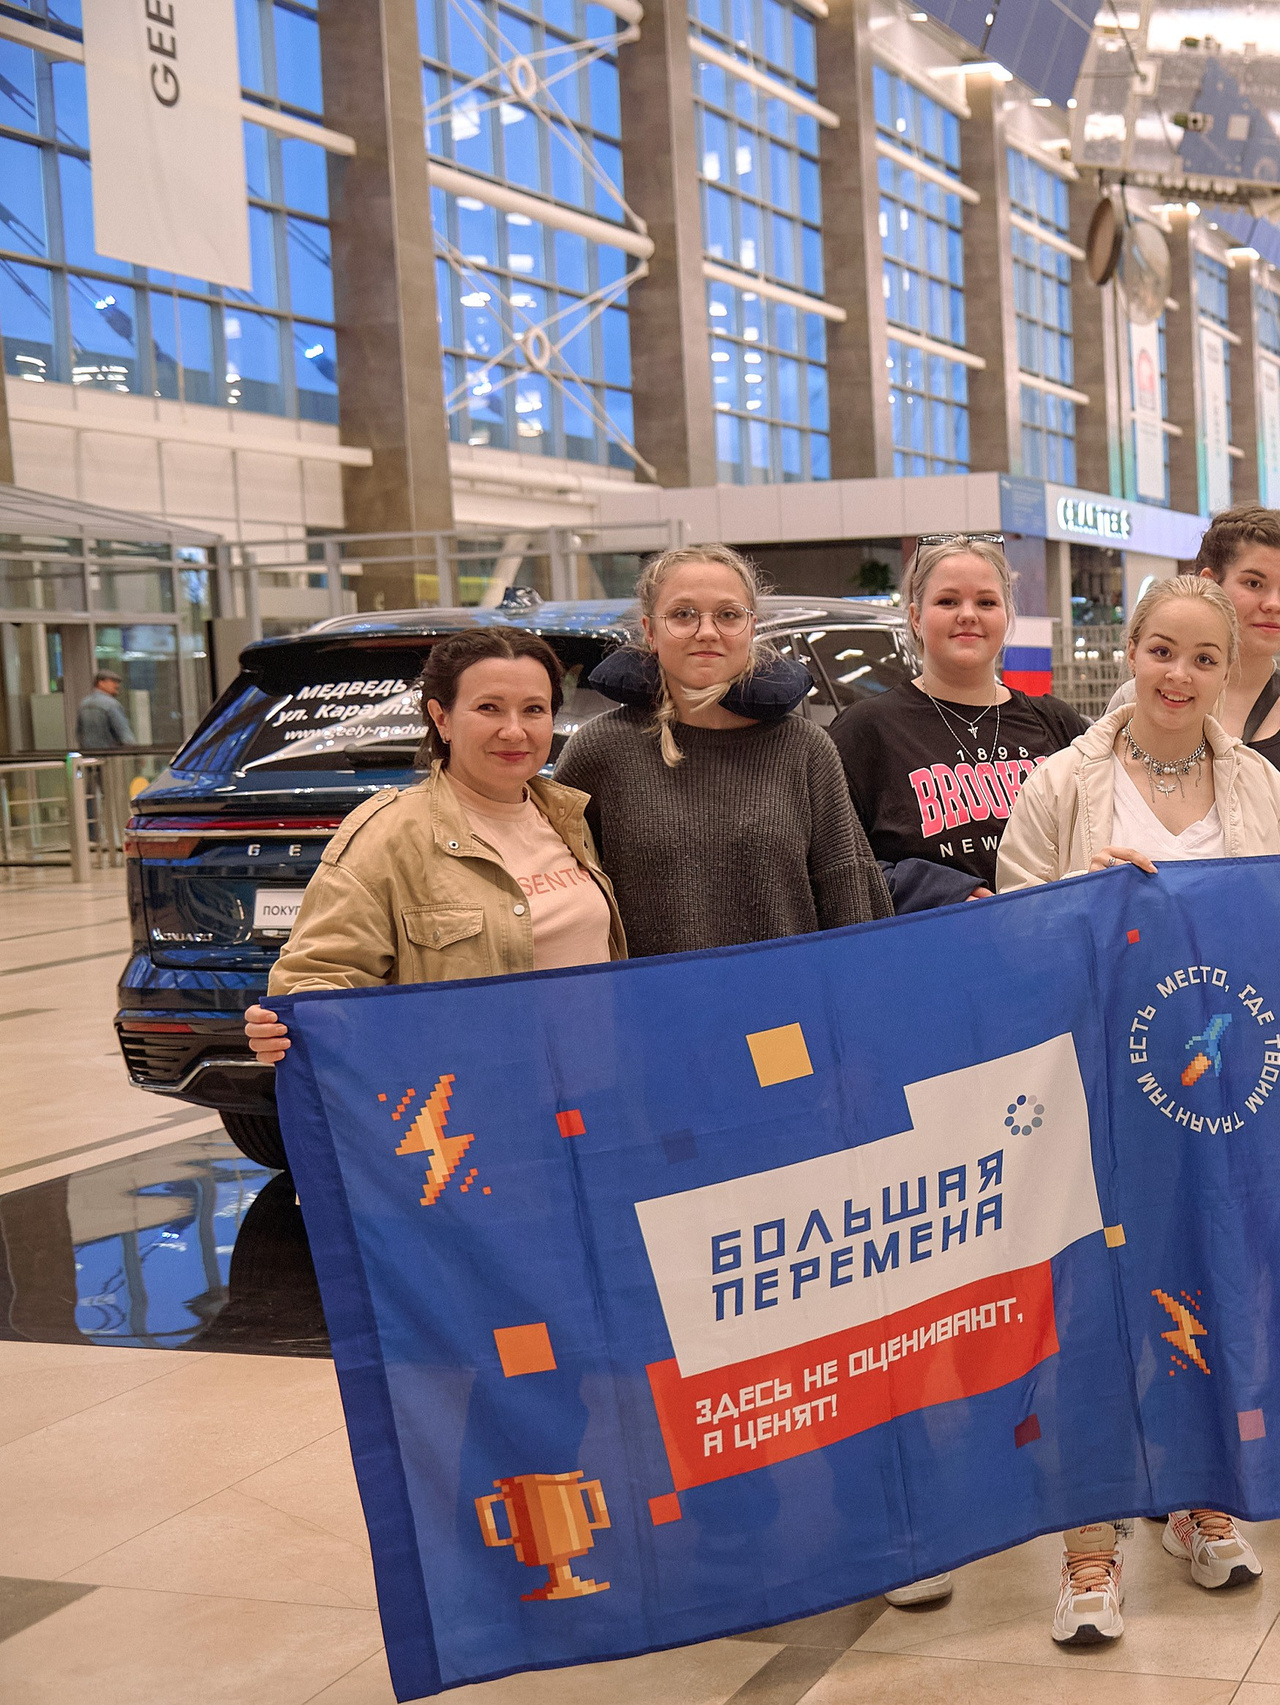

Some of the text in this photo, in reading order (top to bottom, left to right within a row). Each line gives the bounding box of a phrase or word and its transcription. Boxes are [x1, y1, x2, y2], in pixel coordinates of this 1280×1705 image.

[146, 0, 180, 107] GEE
[272, 703, 420, 727] ул. Карауль
[296, 679, 408, 701] МЕДВЕДЬ
[956, 746, 1029, 761] 1898
[908, 755, 1048, 839] BROOK
[939, 835, 998, 858] NEW
[1156, 965, 1230, 999] МЕСТО,
[1237, 983, 1275, 1026] ГДЕ
[1129, 1005, 1157, 1064] ЕСТЬ
[1137, 1071, 1245, 1135] ТАЛАНТАМ
[711, 1148, 1004, 1276] БОЛЬШАЯ
[711, 1192, 1003, 1322] ПЕРЕМЕНА
[695, 1297, 1024, 1425] ЗДЕСЬ НЕ ОЦЕНИВАЮТ,
[704, 1393, 838, 1457] А ЦЕНЯТ!
